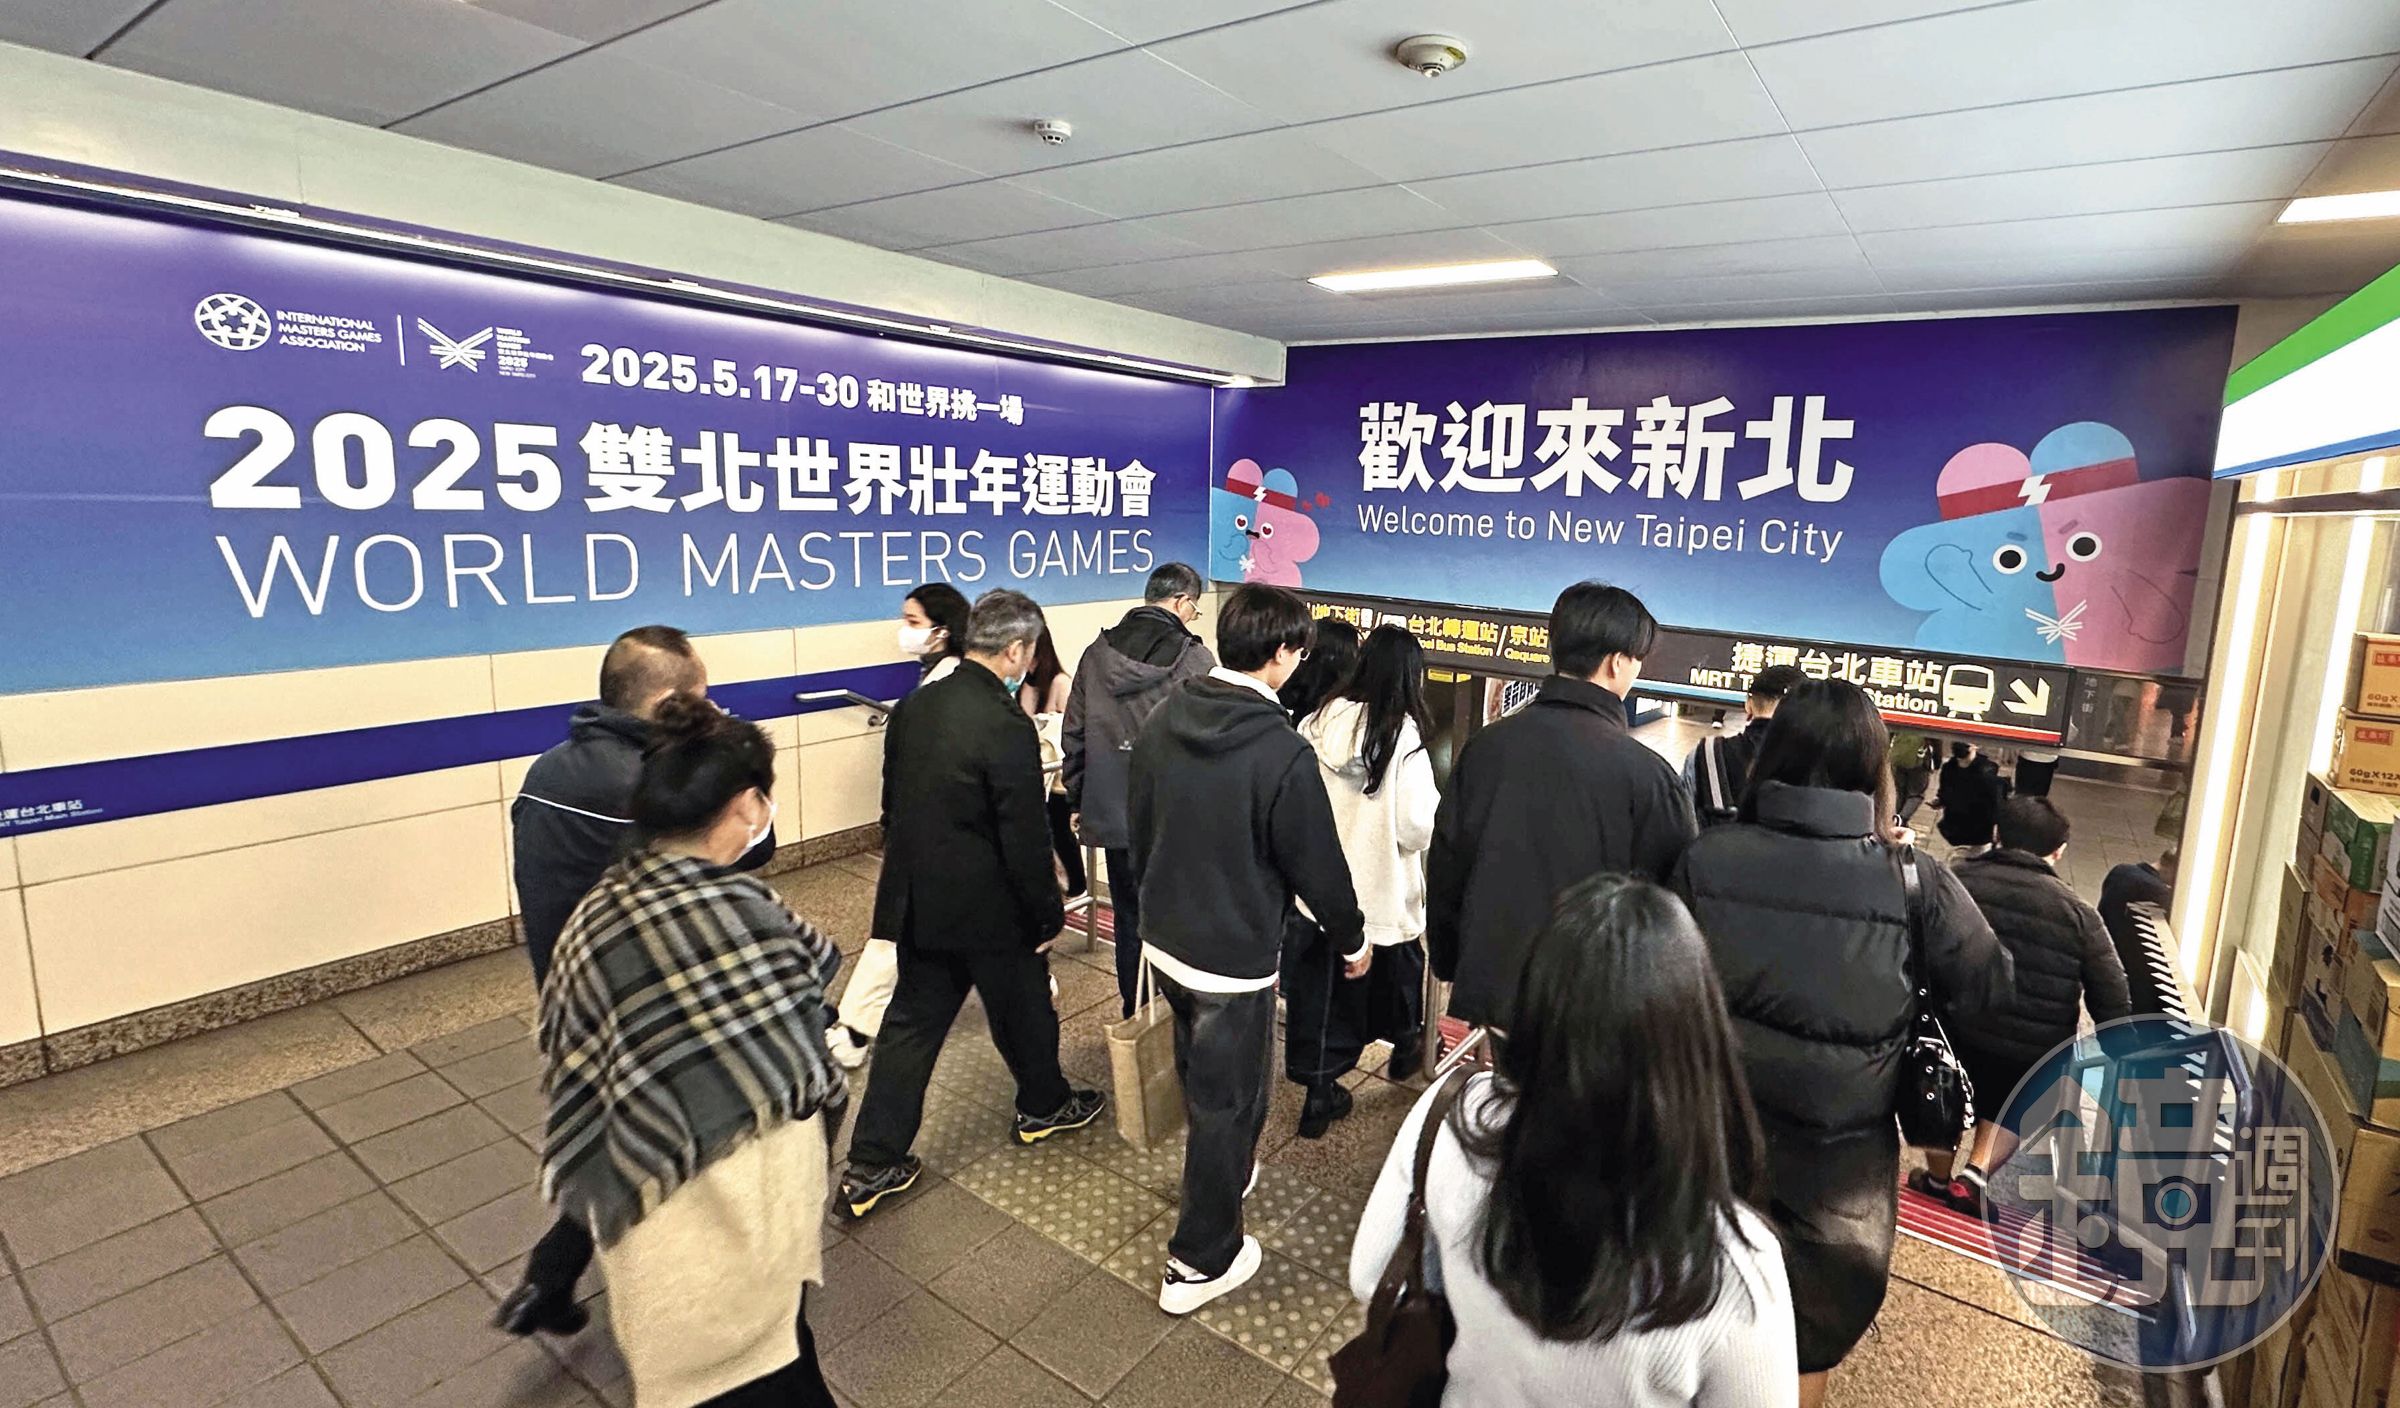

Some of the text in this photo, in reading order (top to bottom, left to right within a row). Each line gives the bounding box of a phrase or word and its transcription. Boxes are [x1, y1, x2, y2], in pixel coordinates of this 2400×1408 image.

[276, 310, 375, 331] INTERNATIONAL
[279, 323, 382, 343] MASTERS GAMES
[279, 335, 365, 352] ASSOCIATION
[581, 343, 1024, 426] 2025.5.17-30 和世界挑一場
[1358, 395, 1855, 502] 歡迎來新北
[1357, 504, 1844, 563] Welcome to New Taipei City
[215, 529, 1153, 618] WORLD MASTERS GAMES
[1436, 639, 1456, 652] Bus
[1457, 642, 1493, 657] Station
[1690, 668, 1736, 689] MRT
